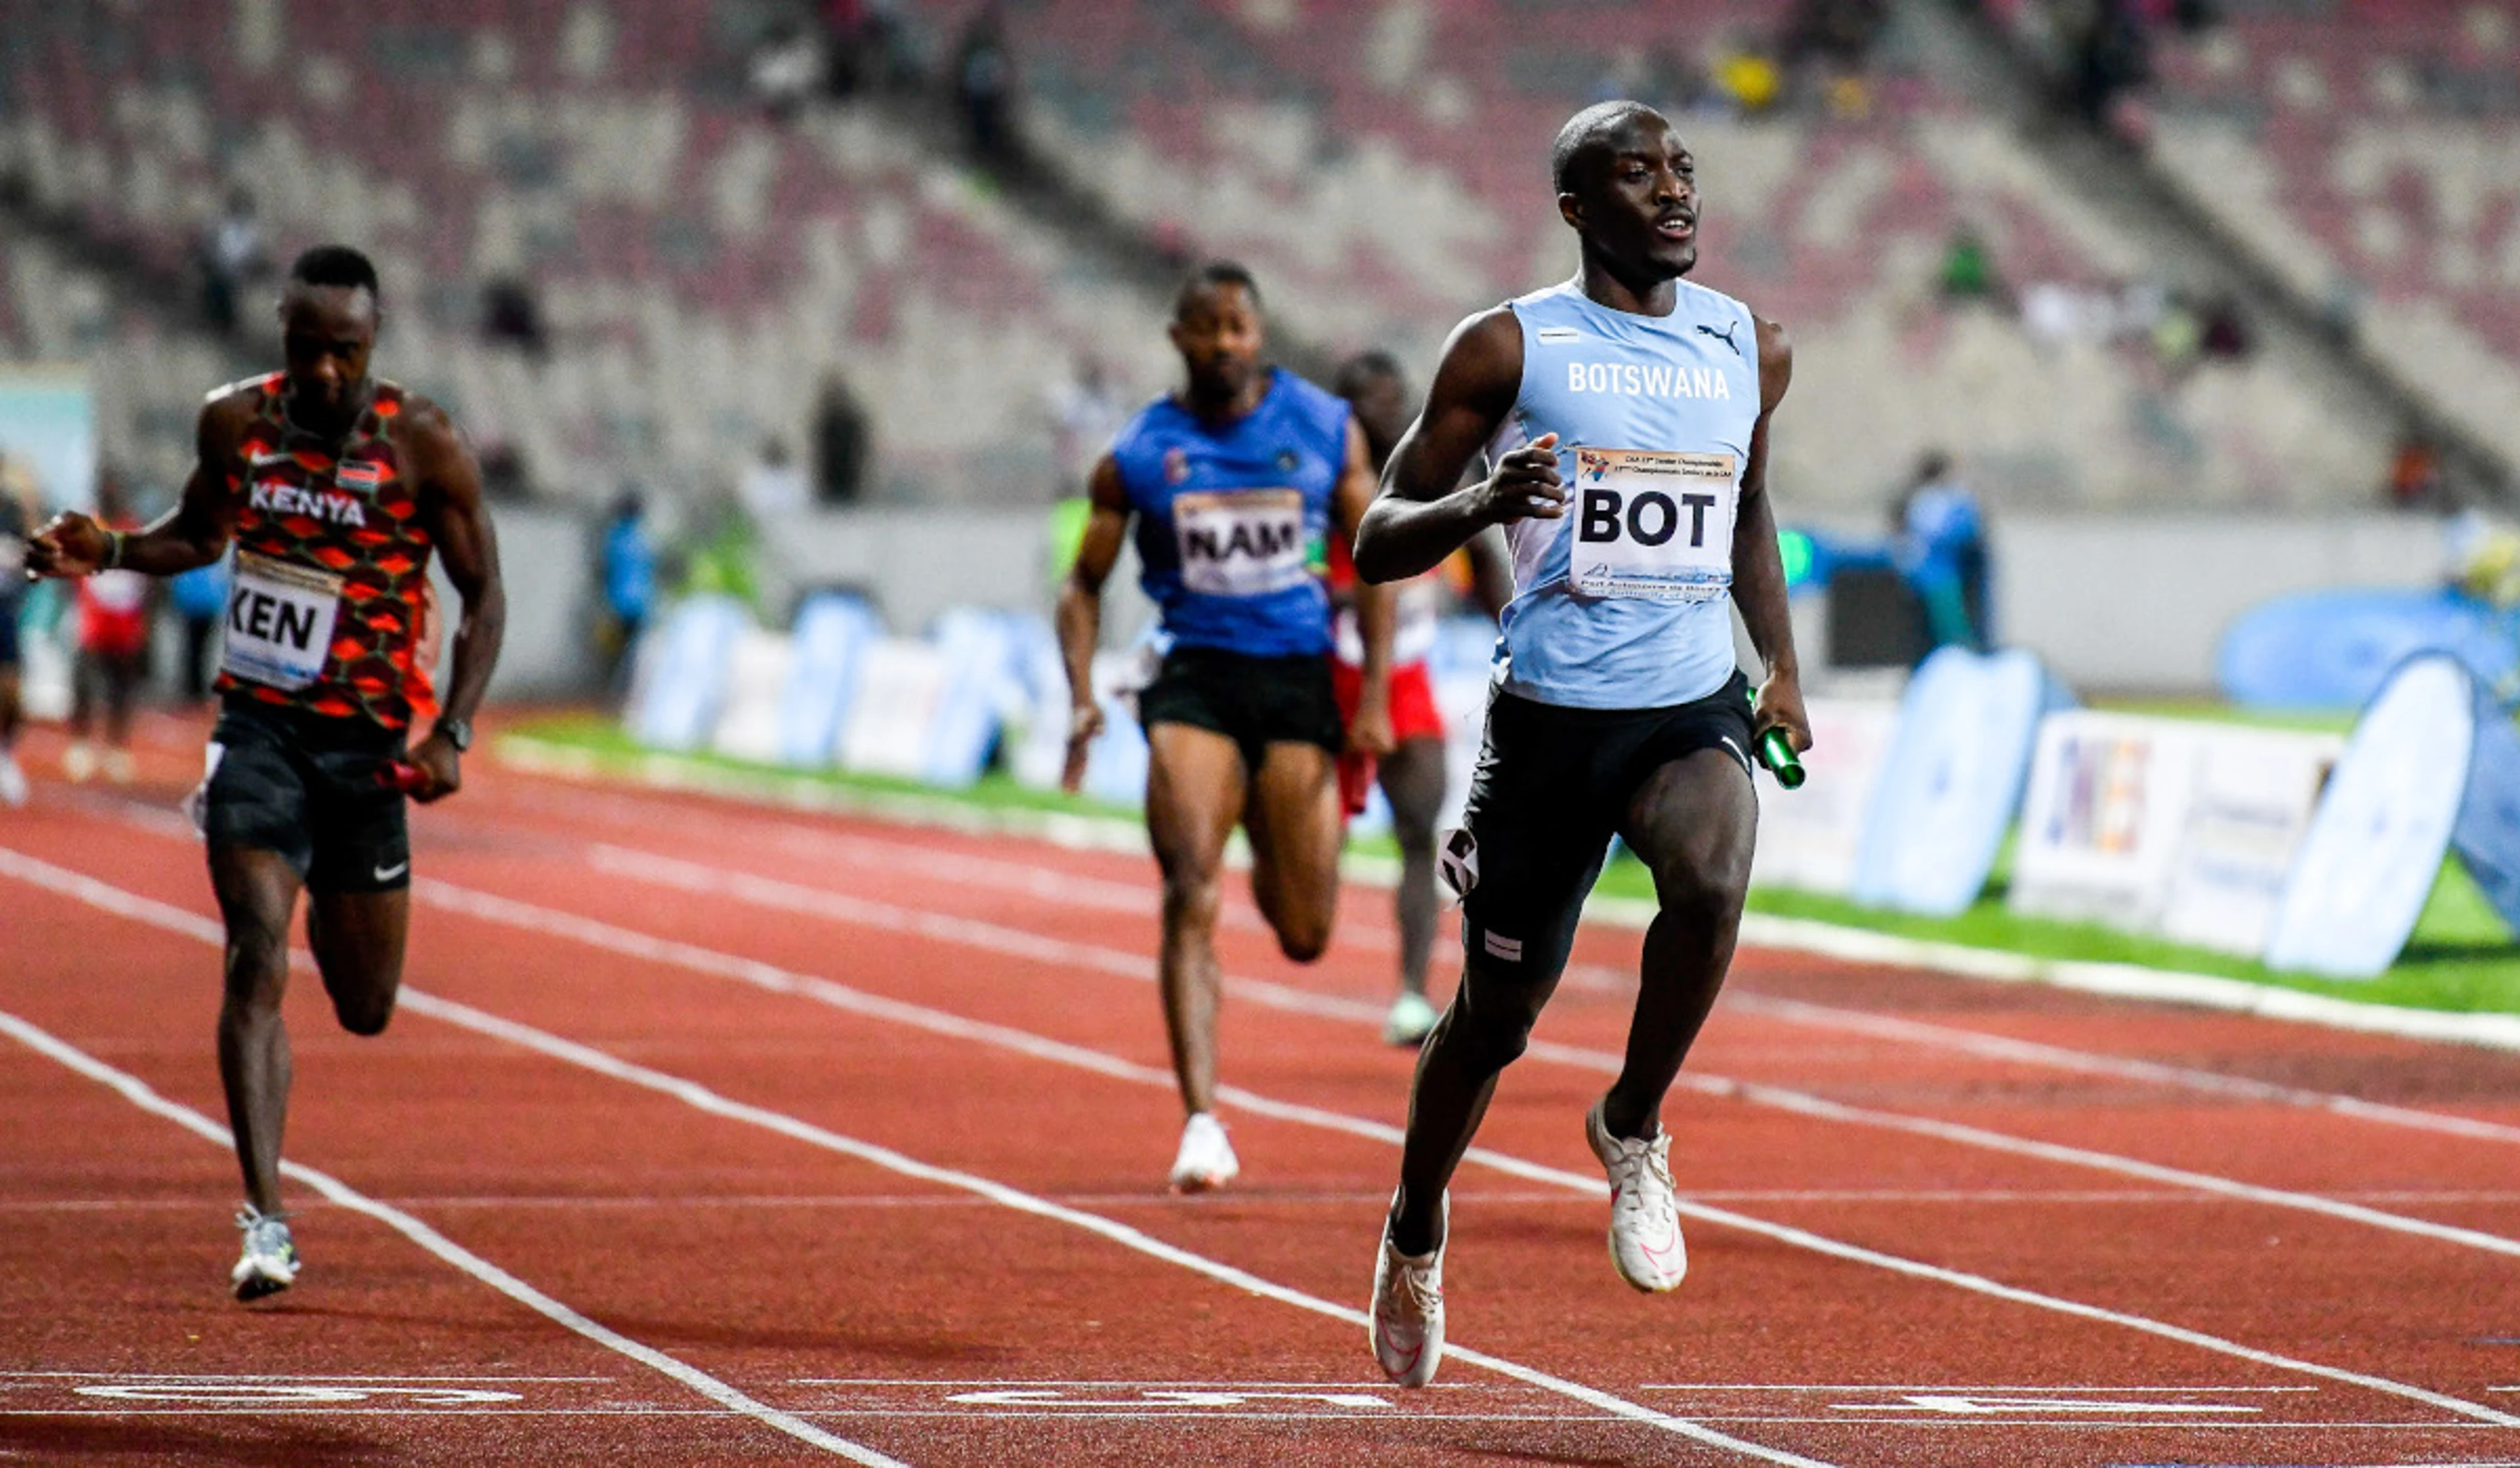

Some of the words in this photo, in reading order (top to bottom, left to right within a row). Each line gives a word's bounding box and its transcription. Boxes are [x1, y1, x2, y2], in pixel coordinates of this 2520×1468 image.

[1568, 362, 1731, 400] BOTSWANA
[250, 481, 366, 527] KENYA
[1579, 489, 1715, 547] BOT
[1186, 522, 1294, 560] NAM
[231, 587, 316, 650] KEN
